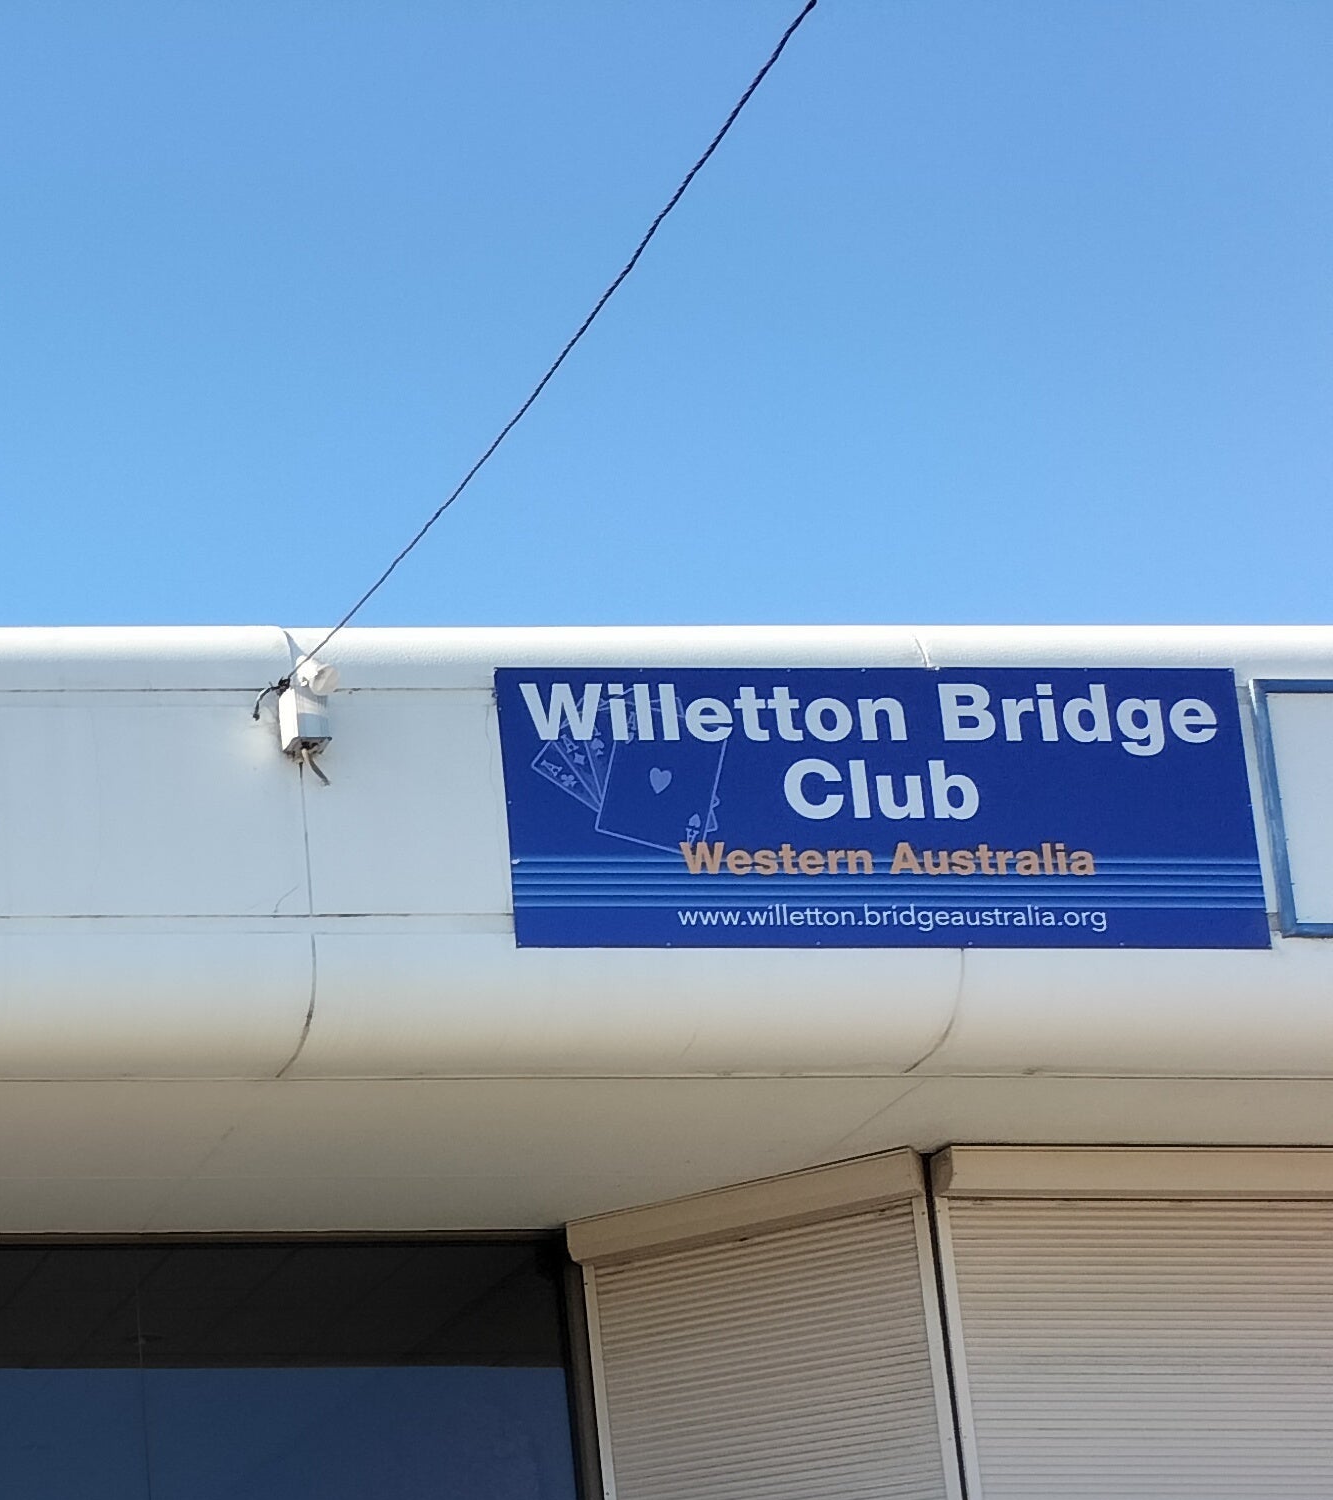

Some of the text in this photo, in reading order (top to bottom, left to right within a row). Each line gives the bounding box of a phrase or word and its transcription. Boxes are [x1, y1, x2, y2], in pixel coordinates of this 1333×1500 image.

[519, 684, 1217, 757] Willetton Bridge
[783, 758, 979, 820] Club
[679, 842, 1096, 876] Western Australia
[678, 904, 1107, 931] www.willetton.bridgeaustralia.org
